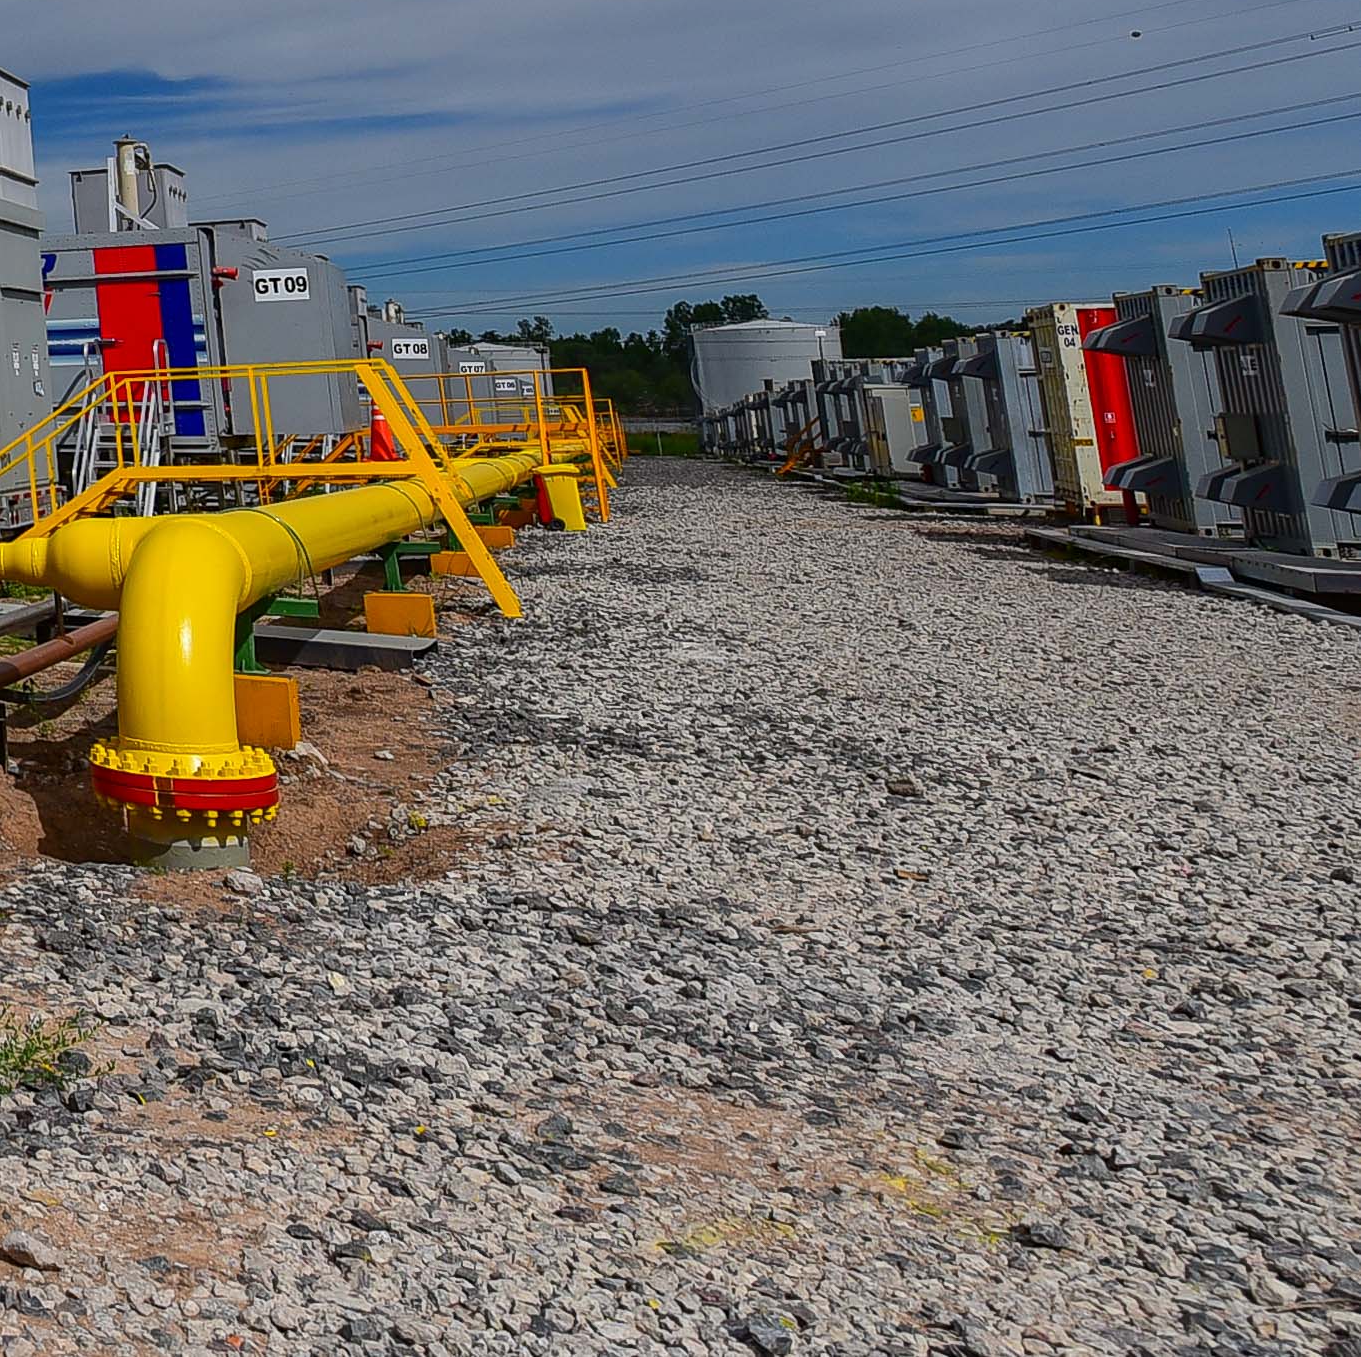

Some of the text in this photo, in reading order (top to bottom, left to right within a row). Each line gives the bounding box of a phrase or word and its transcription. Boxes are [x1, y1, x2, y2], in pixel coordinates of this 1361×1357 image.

[255, 275, 307, 294] GT 09
[1057, 324, 1079, 336] GEN
[1064, 337, 1076, 347] 04
[393, 343, 428, 355] GT 08
[461, 365, 484, 374] GT 07
